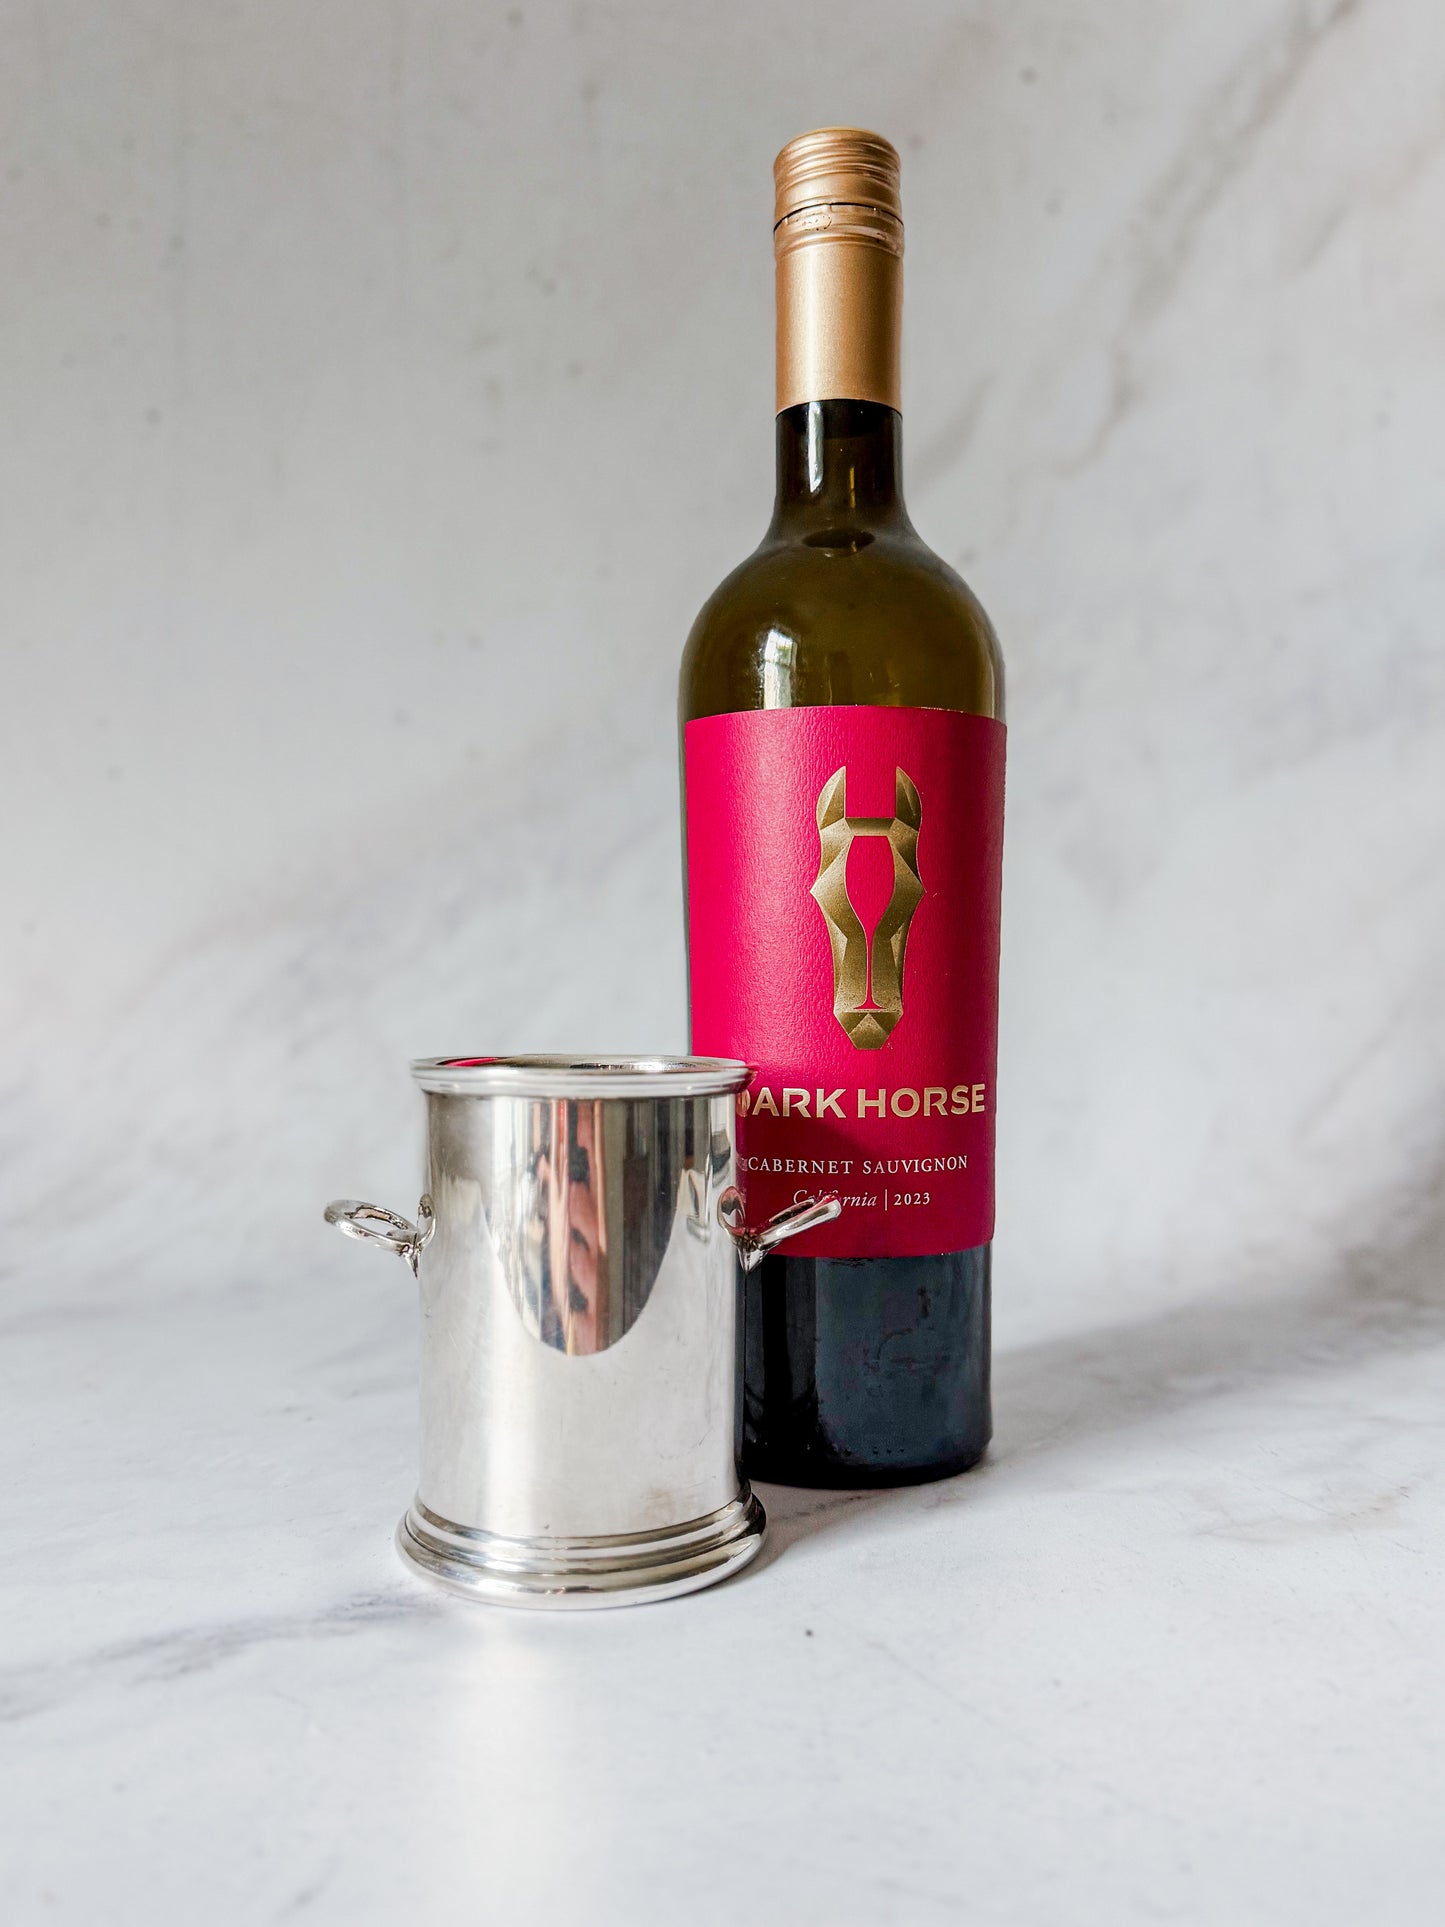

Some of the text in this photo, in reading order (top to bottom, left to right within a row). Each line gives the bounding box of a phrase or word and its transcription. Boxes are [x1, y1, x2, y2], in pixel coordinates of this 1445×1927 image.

[745, 1083, 986, 1119] ARK HORSE
[748, 1155, 968, 1175] CABERNET SAUVIGNON
[893, 1192, 931, 1206] 2023
